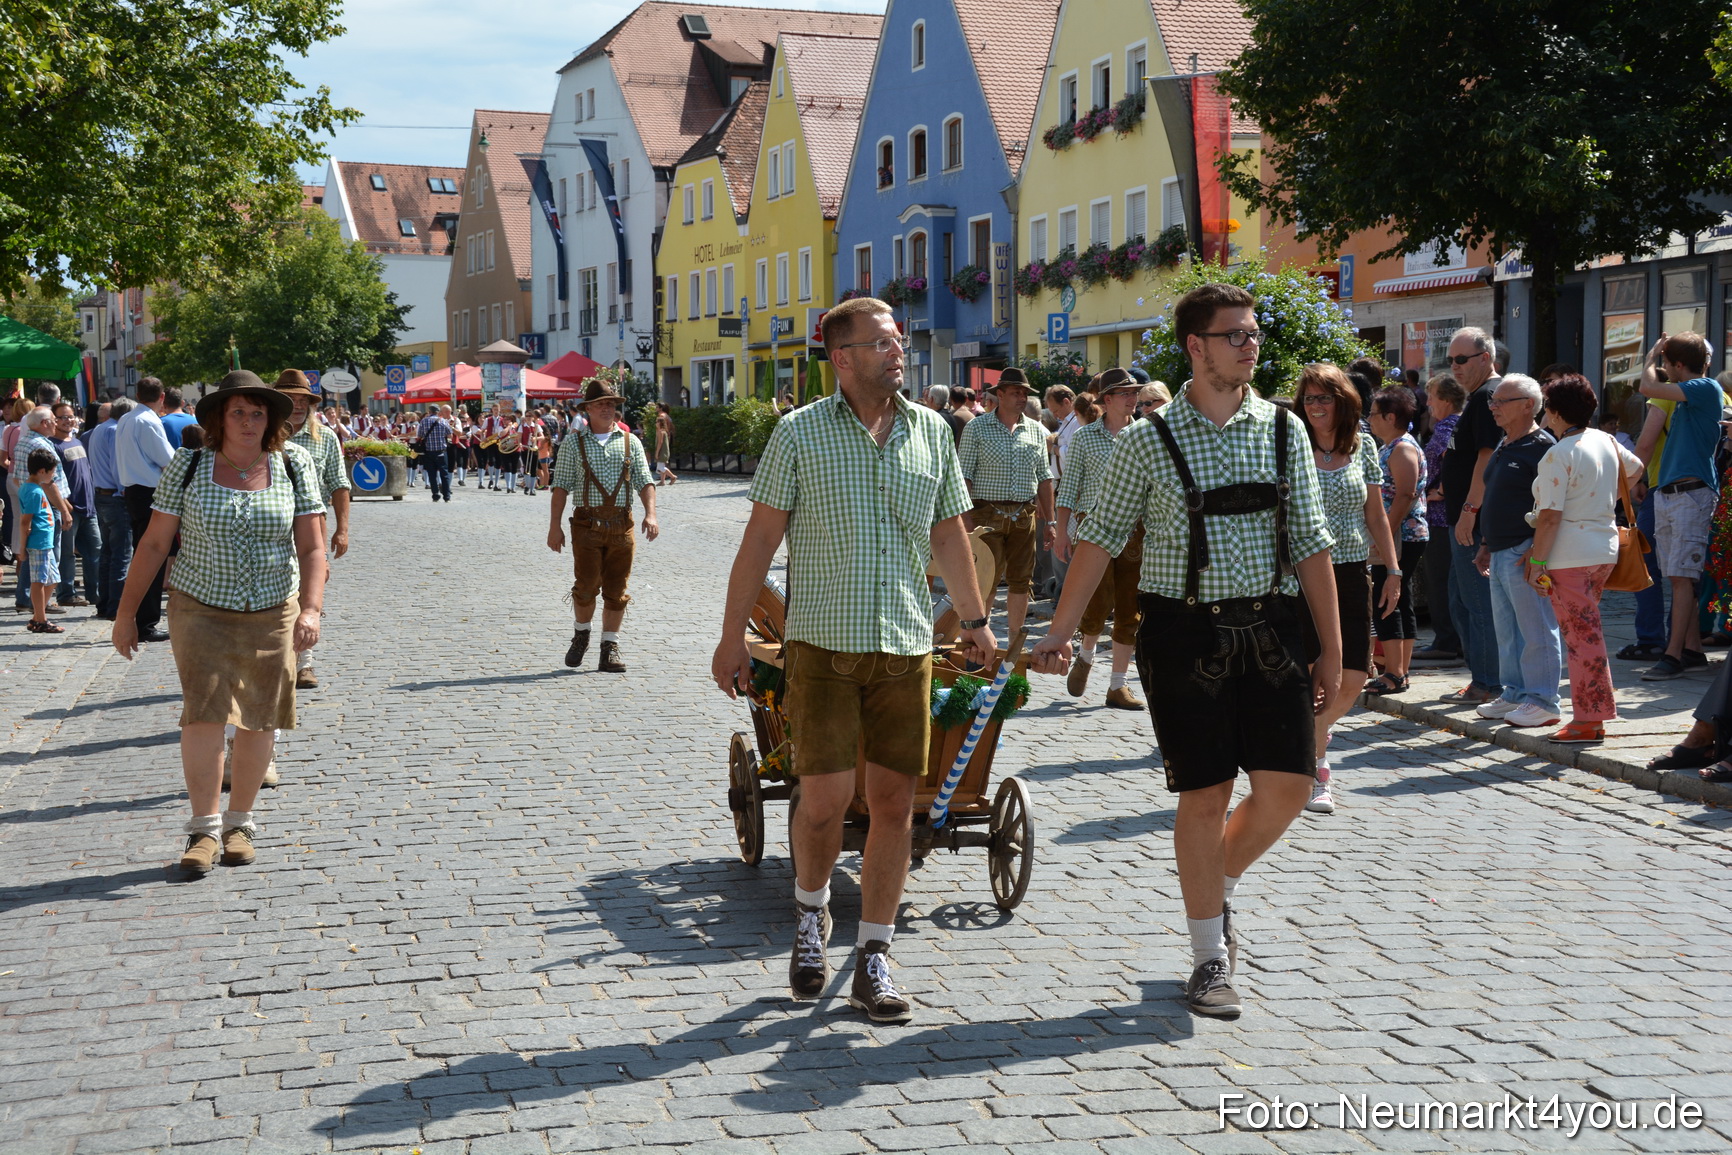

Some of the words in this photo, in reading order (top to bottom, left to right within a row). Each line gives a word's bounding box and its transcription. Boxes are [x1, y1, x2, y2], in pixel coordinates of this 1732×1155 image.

[694, 244, 715, 264] HOTEL
[720, 240, 743, 257] Lehmeier
[995, 243, 1009, 257] CAFÉ
[1342, 260, 1351, 293] P
[996, 259, 1008, 320] WITTL
[1512, 307, 1520, 318] 16
[1052, 316, 1065, 340] P
[693, 339, 722, 353] Restaurant
